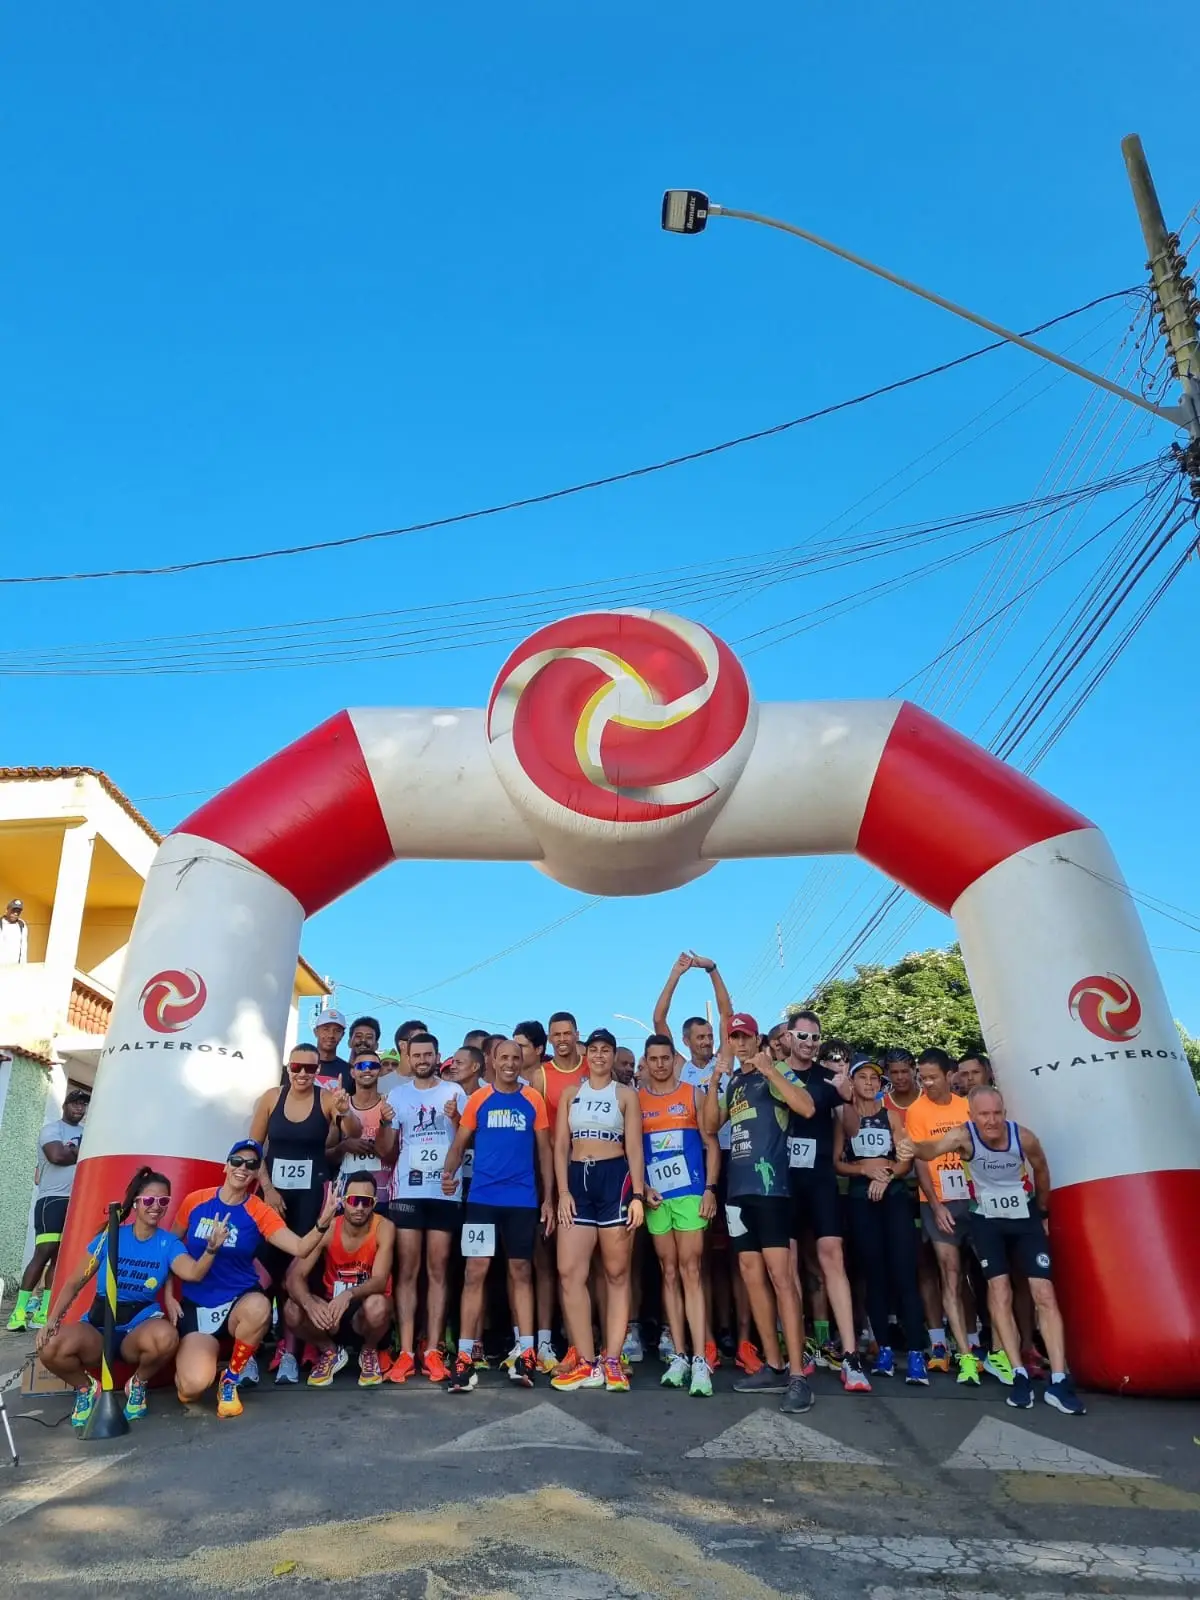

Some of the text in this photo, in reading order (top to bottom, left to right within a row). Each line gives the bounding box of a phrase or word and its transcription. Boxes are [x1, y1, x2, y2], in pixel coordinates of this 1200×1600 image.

[119, 1041, 245, 1060] ALTEROSA
[1029, 1061, 1061, 1076] TV
[585, 1101, 612, 1114] 173
[487, 1109, 527, 1129] MINAS
[859, 1133, 885, 1146] 105
[420, 1149, 438, 1162] 26
[792, 1143, 810, 1157] 87
[279, 1165, 306, 1178] 125
[654, 1162, 682, 1181] 106
[990, 1195, 1020, 1209] 108
[467, 1229, 486, 1244] 94
[117, 1257, 161, 1269] orredores
